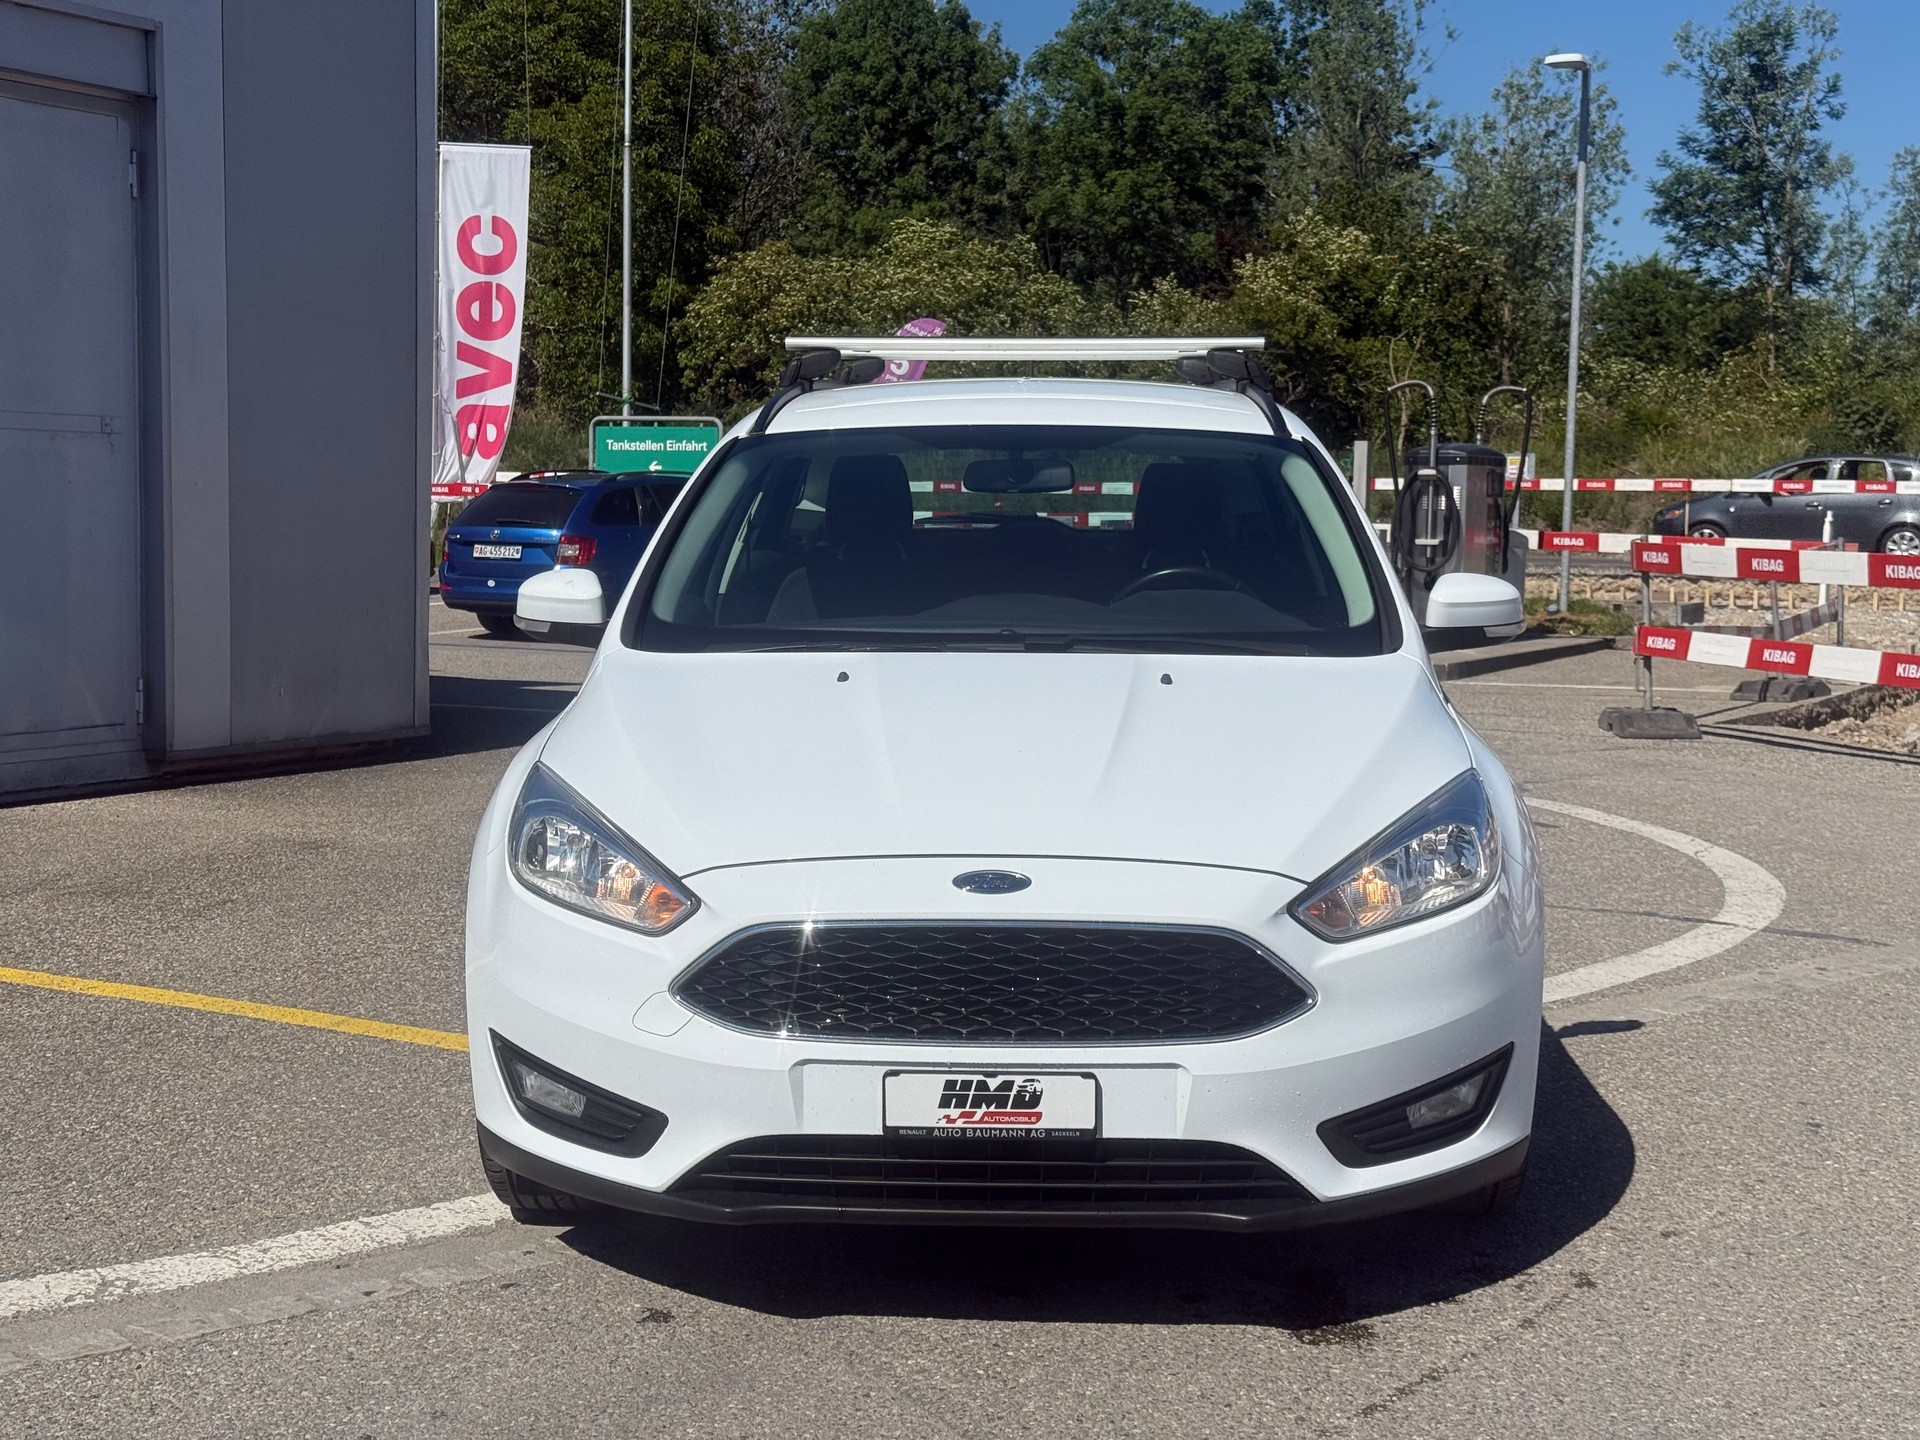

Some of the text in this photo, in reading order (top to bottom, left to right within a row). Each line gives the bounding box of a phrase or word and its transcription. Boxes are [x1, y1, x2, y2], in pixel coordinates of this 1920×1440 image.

[456, 214, 518, 461] avec
[605, 439, 708, 452] Tankstellen Einfahrt
[461, 486, 480, 494] KIBG
[1661, 481, 1684, 489] KIBAG
[1782, 482, 1805, 490] KIBAG
[1865, 483, 1888, 491] KIBAG
[1552, 536, 1585, 547] KIBAG
[1642, 550, 1669, 565] KIBAG
[1751, 557, 1785, 572] KIBAG
[1885, 564, 1920, 580] KIBAG
[1646, 635, 1676, 651] KIBAG
[1762, 648, 1796, 665] KIBAG
[937, 1078, 1044, 1110] HMD
[932, 1128, 962, 1138] AUTO
[966, 1128, 1026, 1138] BAUMANN
[1029, 1128, 1047, 1139] AG
